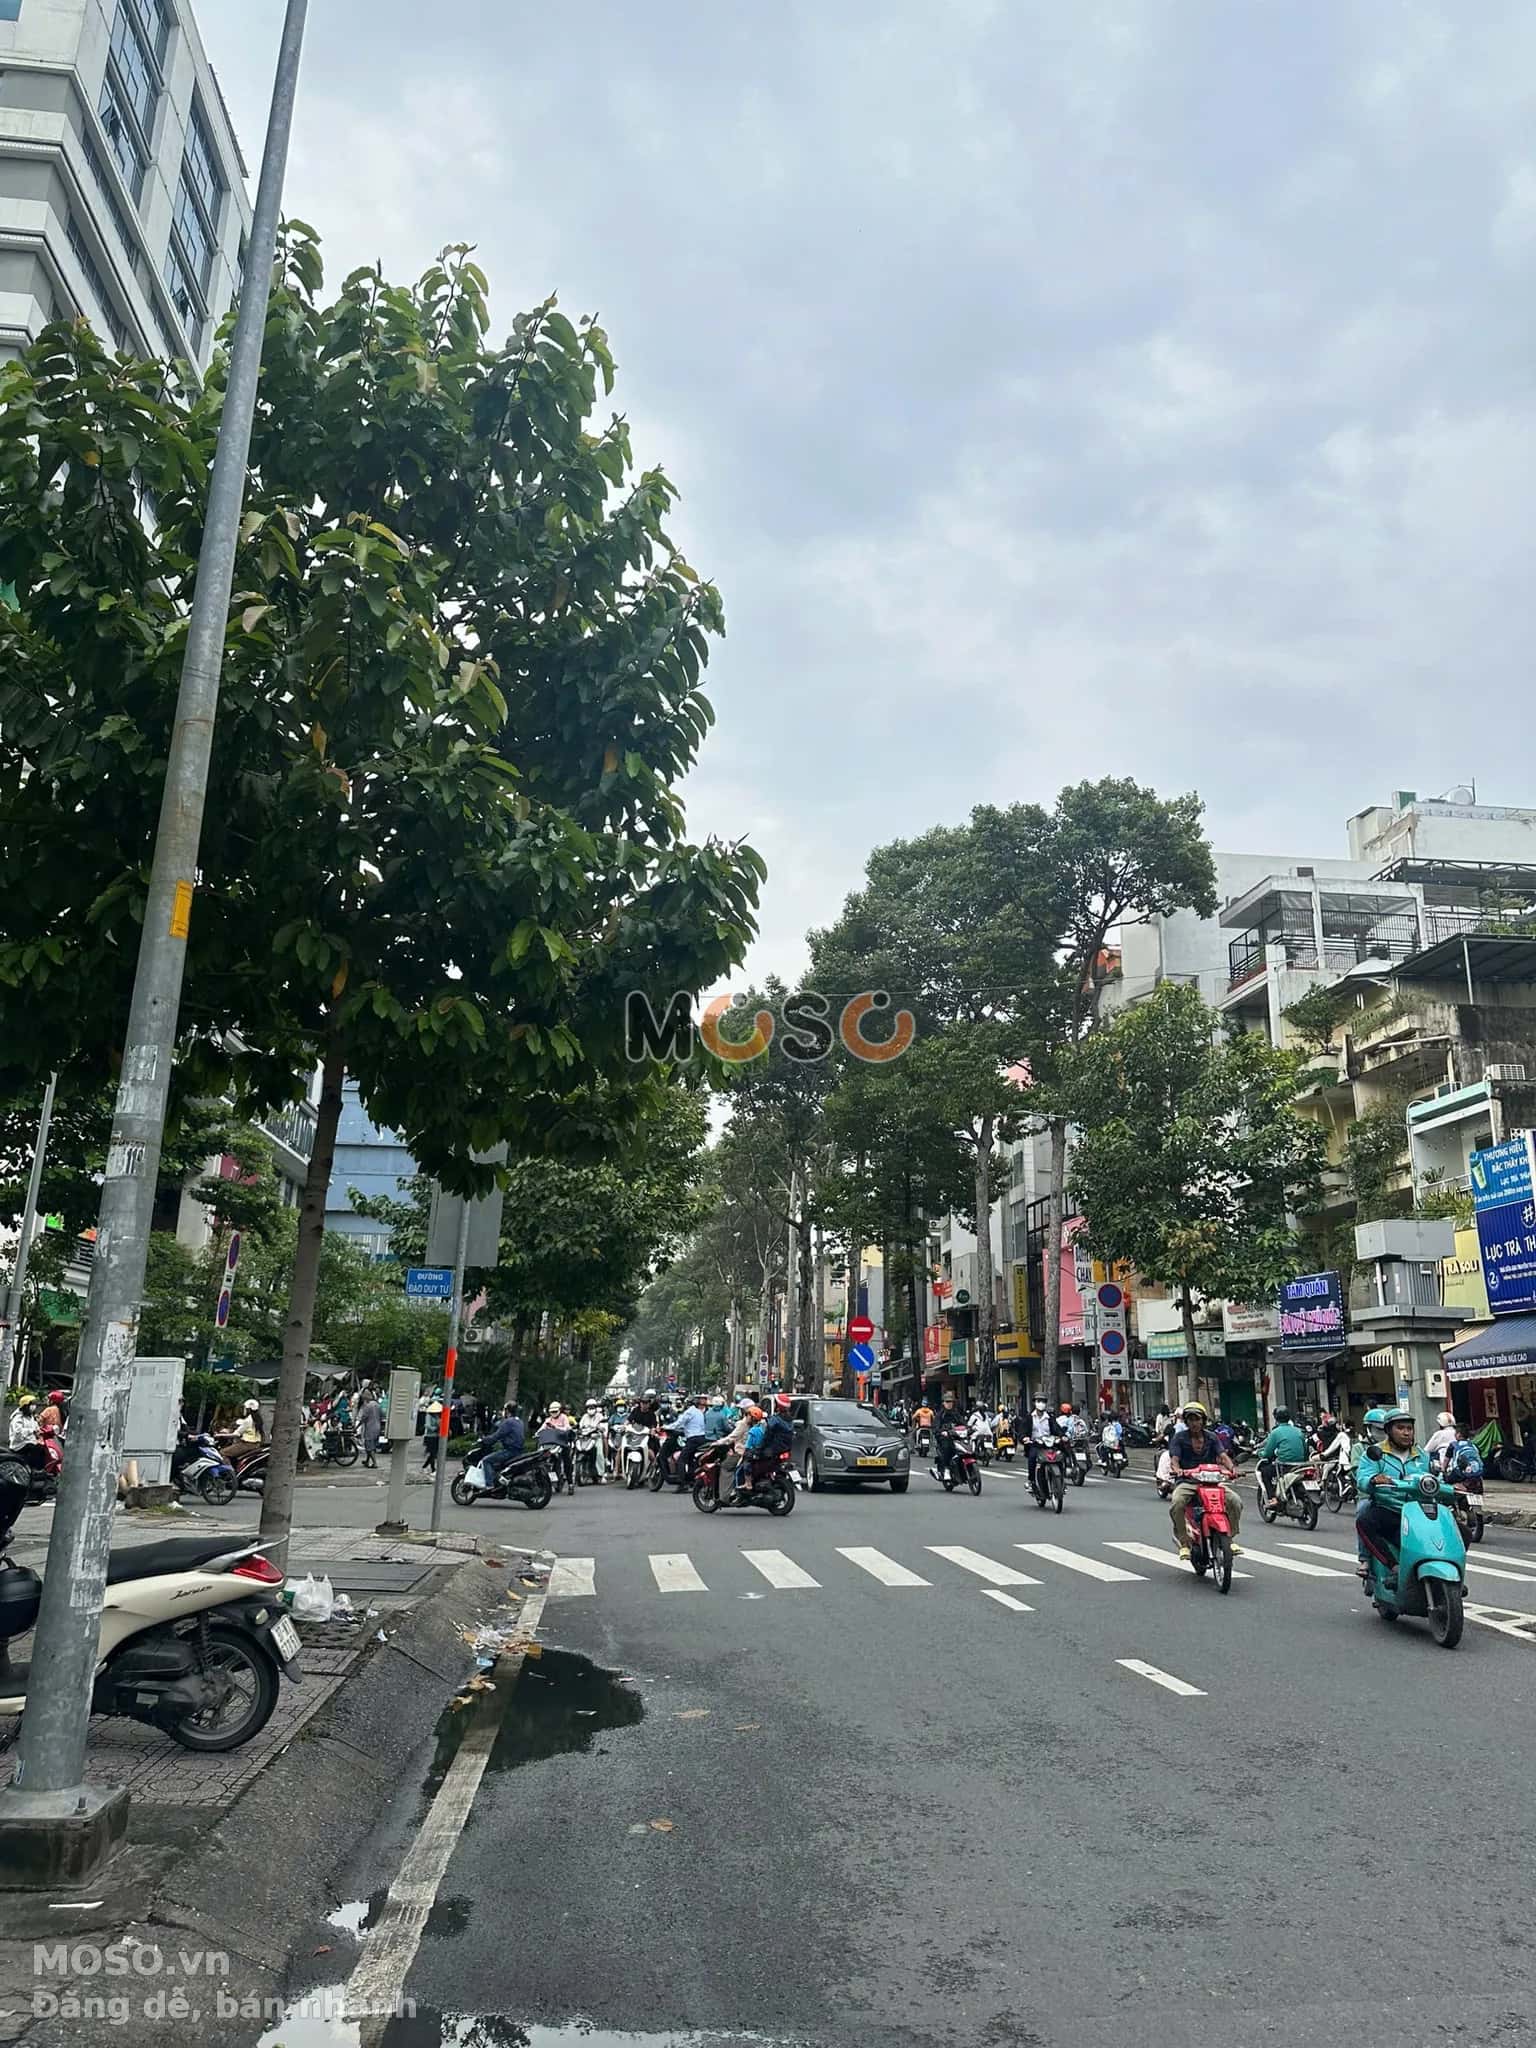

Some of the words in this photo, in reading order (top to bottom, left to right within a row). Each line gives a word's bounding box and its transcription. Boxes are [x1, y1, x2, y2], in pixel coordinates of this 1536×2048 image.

[1485, 1244, 1503, 1262] LỤC
[1504, 1236, 1522, 1256] TRÀ
[1304, 1277, 1329, 1298] QUÁN
[1489, 1271, 1497, 1284] 2
